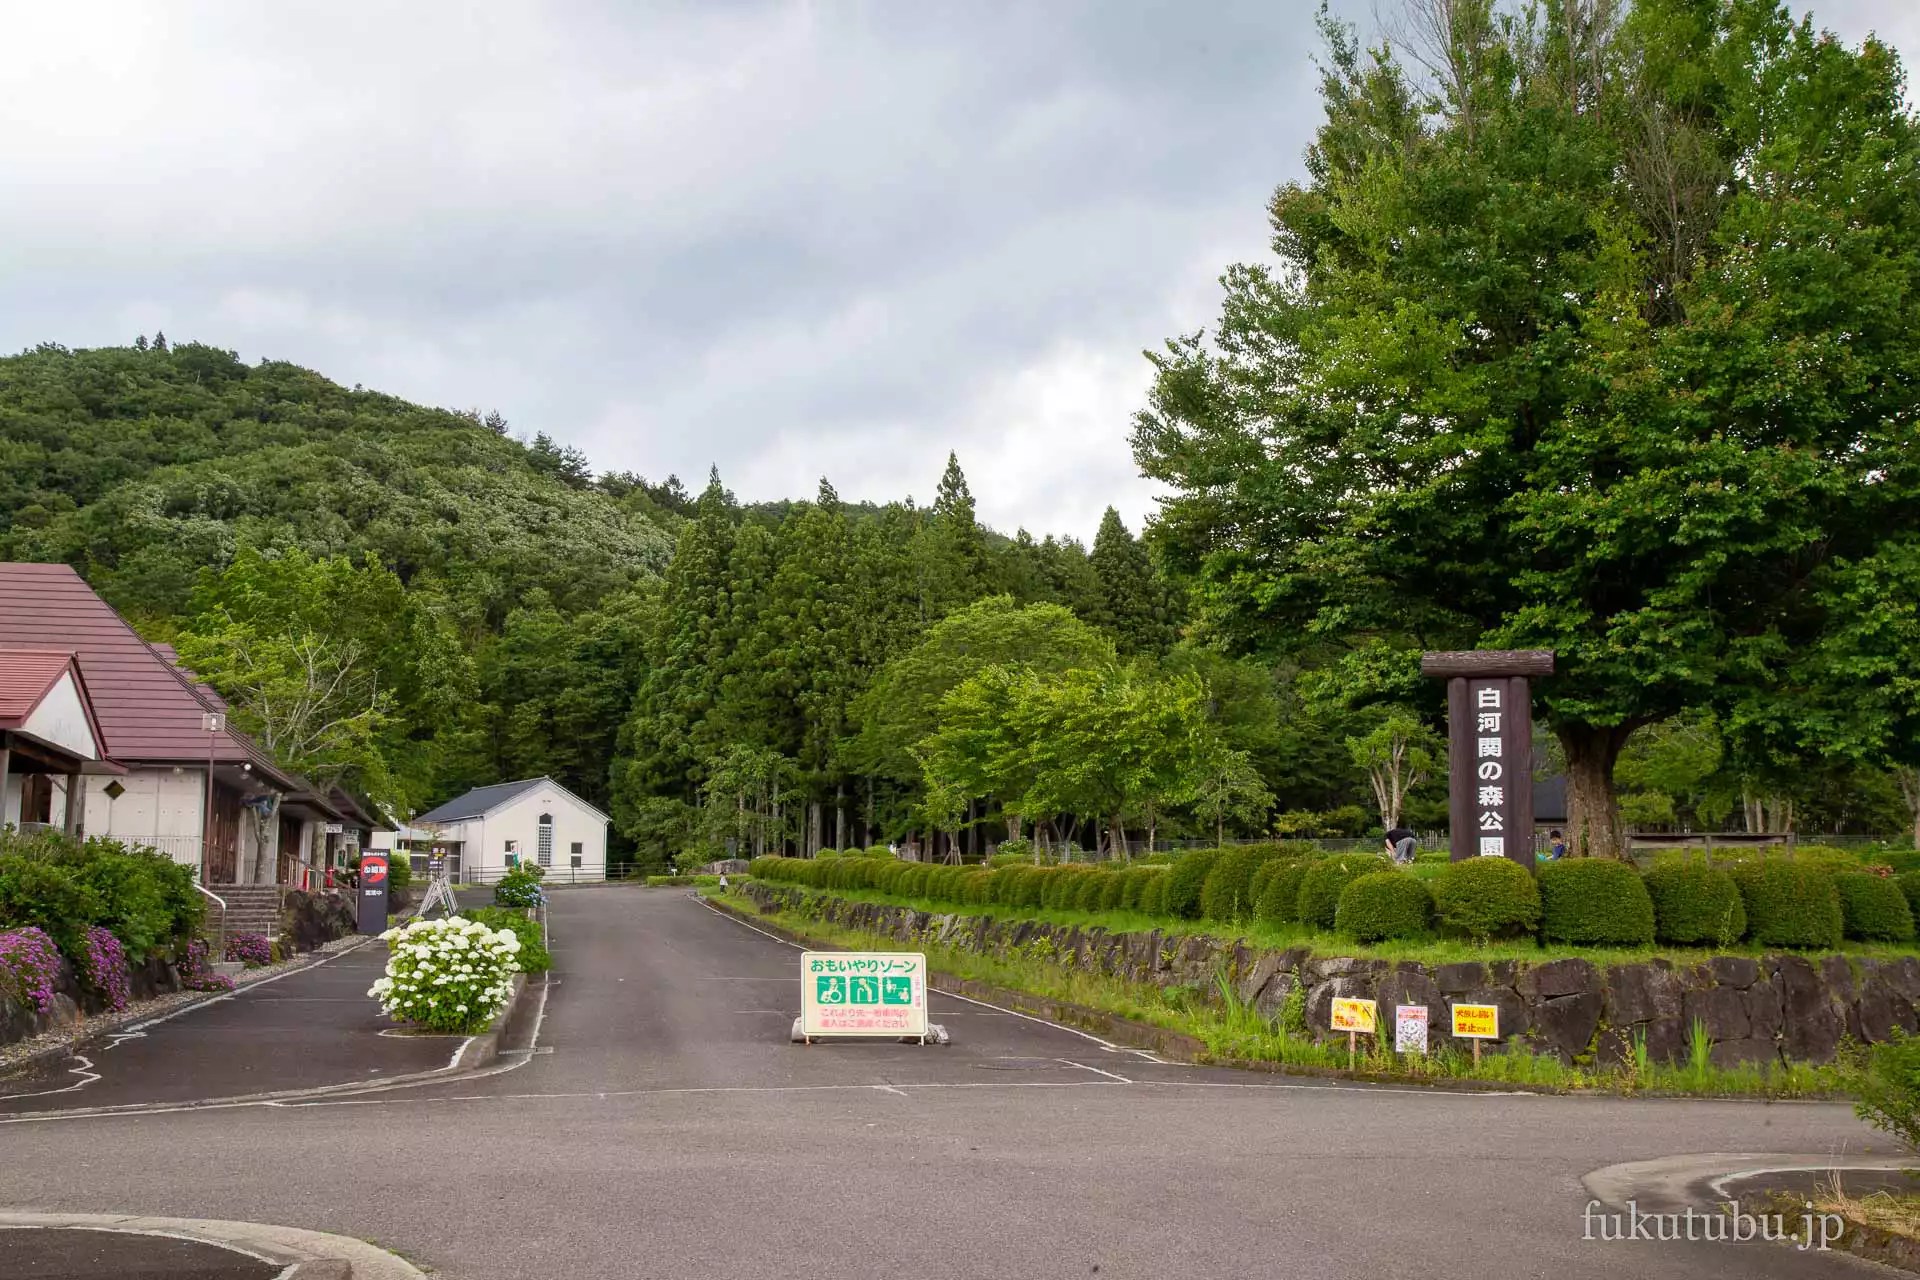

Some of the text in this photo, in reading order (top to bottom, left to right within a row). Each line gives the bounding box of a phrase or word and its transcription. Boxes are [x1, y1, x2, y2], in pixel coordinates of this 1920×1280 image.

[1477, 687, 1504, 857] 白河関の森公園
[811, 959, 916, 972] おもいやりゾーン
